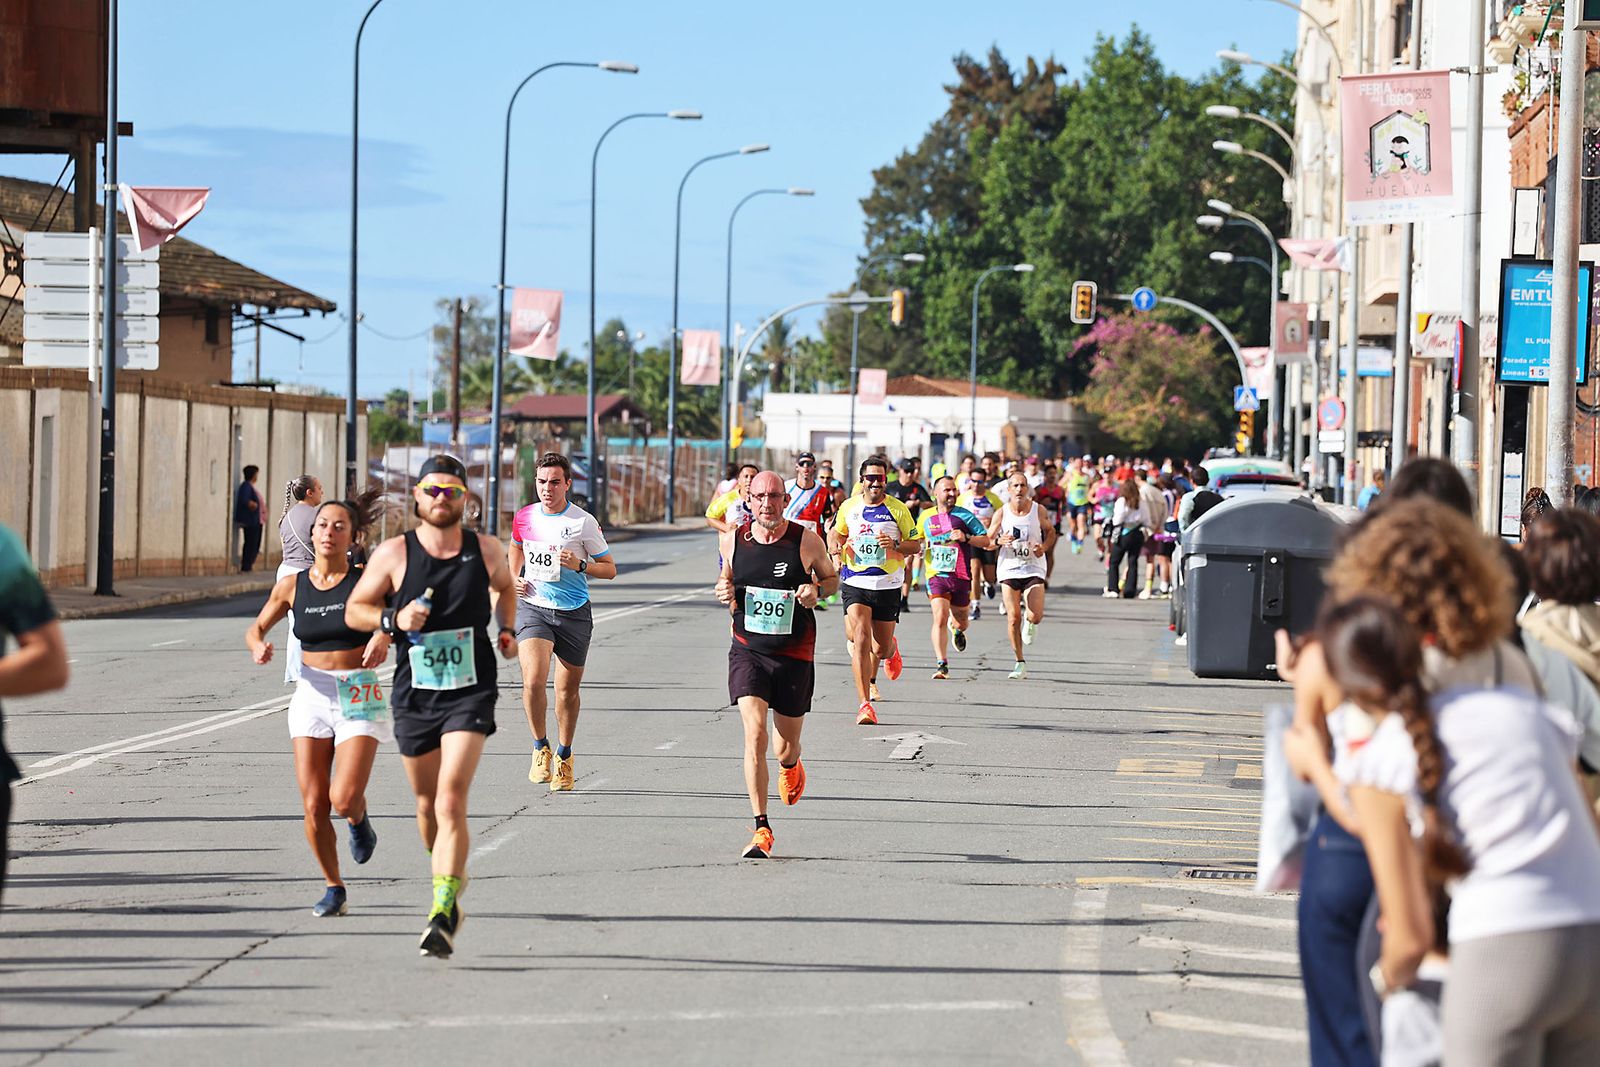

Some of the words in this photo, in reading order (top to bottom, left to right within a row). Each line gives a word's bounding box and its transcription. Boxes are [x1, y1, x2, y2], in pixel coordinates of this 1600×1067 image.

[1360, 83, 1392, 96] FERIA
[1380, 92, 1415, 106] LIBRO
[1366, 184, 1432, 197] HUELVA
[859, 524, 875, 534] 2K
[859, 544, 880, 555] 467
[1012, 548, 1030, 557] 140
[529, 551, 552, 567] 248
[305, 604, 324, 614] NIKE
[325, 603, 345, 612] PRO
[753, 600, 785, 617] 296
[423, 646, 462, 667] 540
[349, 684, 383, 704] 276
